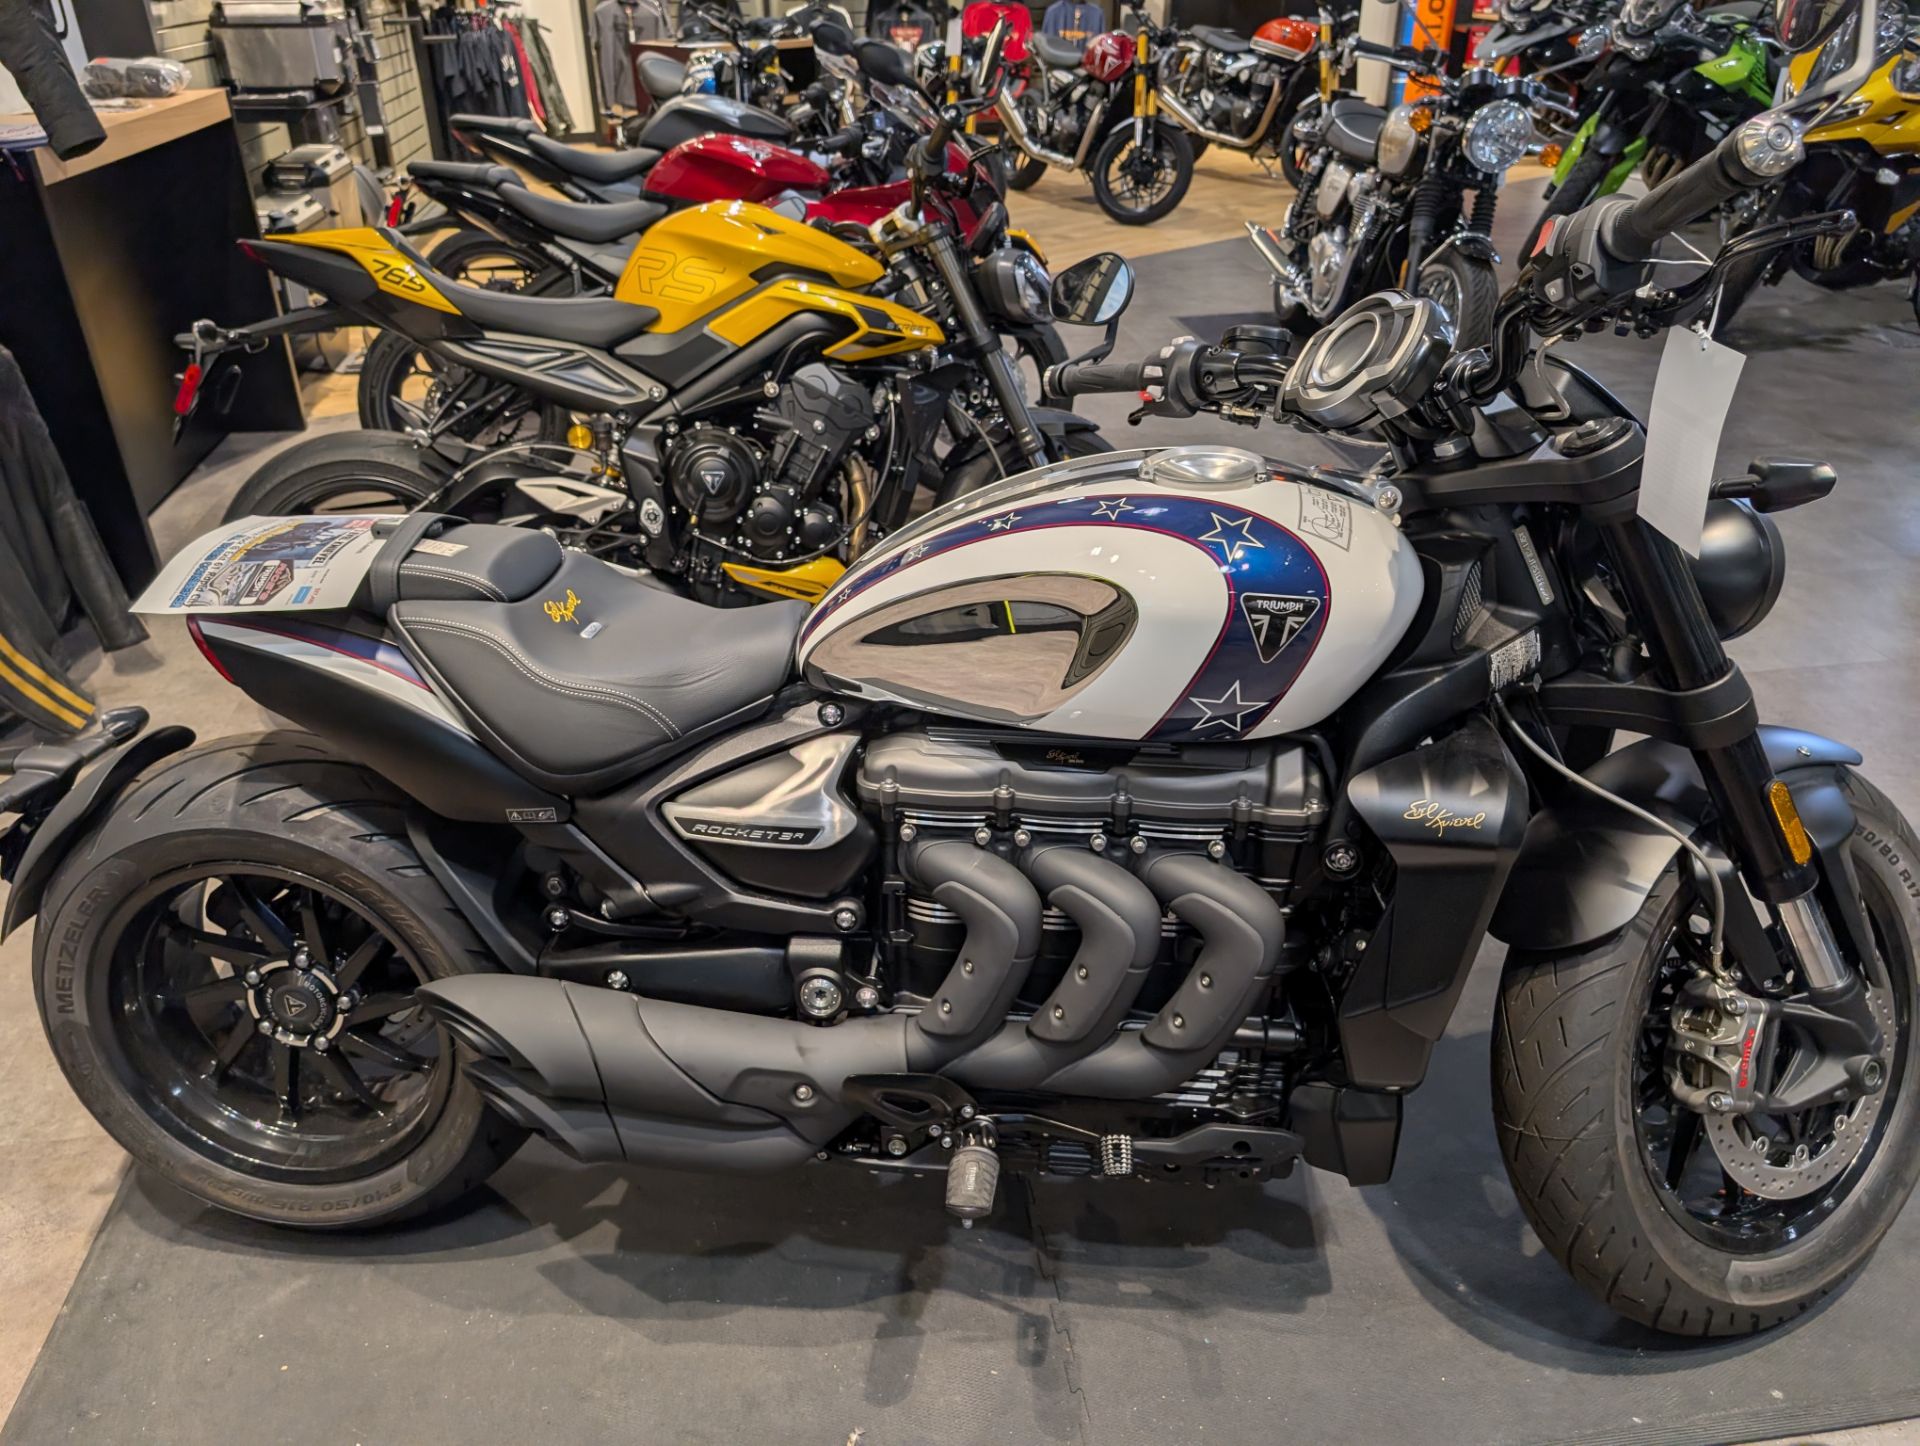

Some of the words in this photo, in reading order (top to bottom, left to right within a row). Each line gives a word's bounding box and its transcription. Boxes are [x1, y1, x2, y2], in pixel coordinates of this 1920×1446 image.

[372, 258, 426, 292] 765
[621, 246, 727, 303] RS
[1256, 599, 1304, 612] TRIUMPH
[56, 886, 108, 1014] METZELER
[1736, 1026, 1756, 1089] brembo
